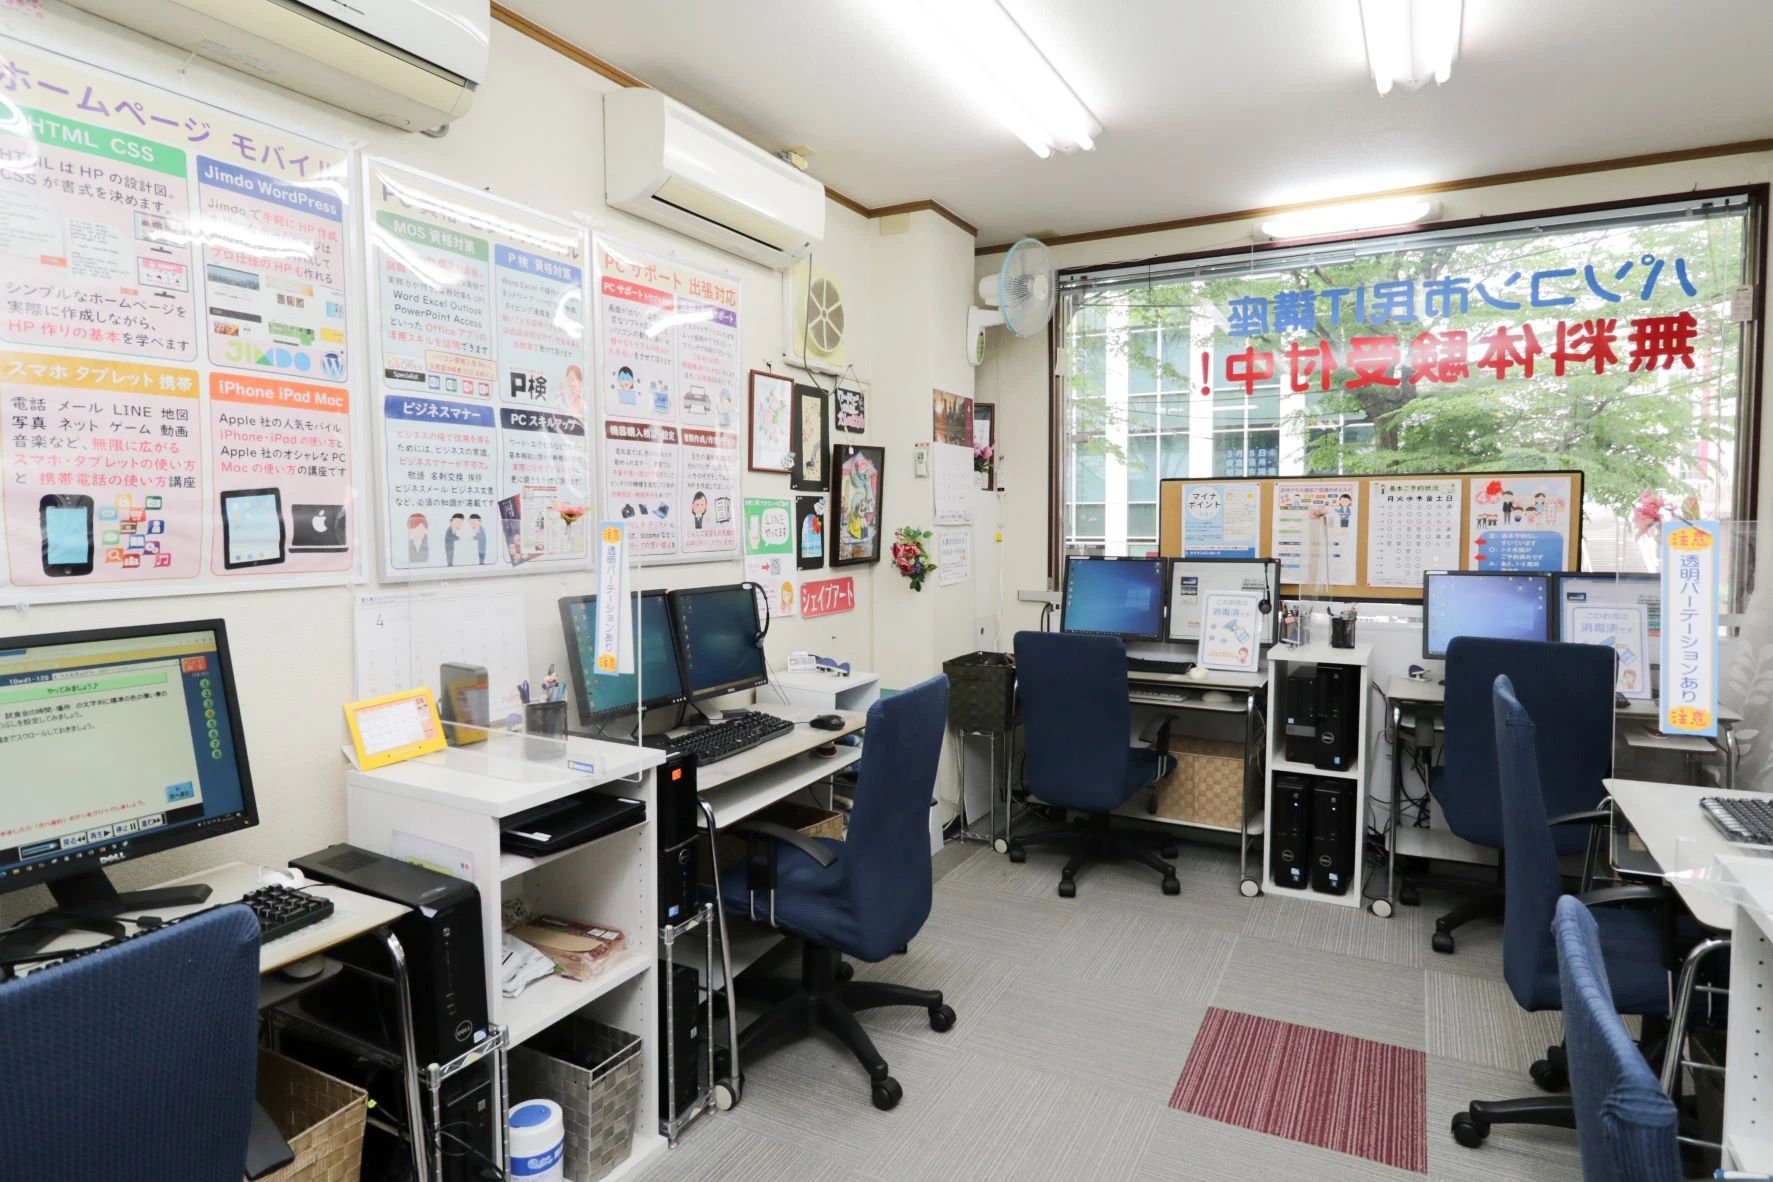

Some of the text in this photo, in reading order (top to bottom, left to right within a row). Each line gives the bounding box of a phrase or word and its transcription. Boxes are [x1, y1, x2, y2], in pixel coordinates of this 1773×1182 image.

[29, 114, 155, 163] HTML CSS
[0, 169, 37, 186] CSS
[80, 165, 104, 180] HP
[205, 164, 338, 215] Jimdo WordPress
[393, 219, 426, 240] MOS
[6, 281, 187, 318] シンプルなホームページを
[393, 289, 483, 316] Word Excel Outlook
[688, 275, 738, 308] 出張対応
[8, 300, 157, 332] 実際に作成しながら、
[394, 304, 483, 329] PowerPoint Access
[7, 360, 192, 391] スマホ タブレット 携帯
[218, 380, 344, 408] iPhone iPad Mac
[11, 395, 189, 421] 電話 メール LINE 地図
[403, 401, 481, 420] ビジネスマナー
[12, 415, 188, 438] 写真 ネット ゲーム 動画
[219, 413, 256, 428] Apple
[12, 434, 181, 455] 音楽など、無限に広がる
[220, 445, 257, 460] Apple
[332, 452, 347, 463] PC
[221, 461, 248, 474] Mac
[1187, 501, 1221, 510] ポイント
[1192, 493, 1218, 501] マイナ
[803, 581, 854, 614] シェイプアート
[1679, 554, 1700, 704] 透明パーテーションあり
[1671, 709, 1708, 728] 注意
[100, 852, 126, 864] DELL
